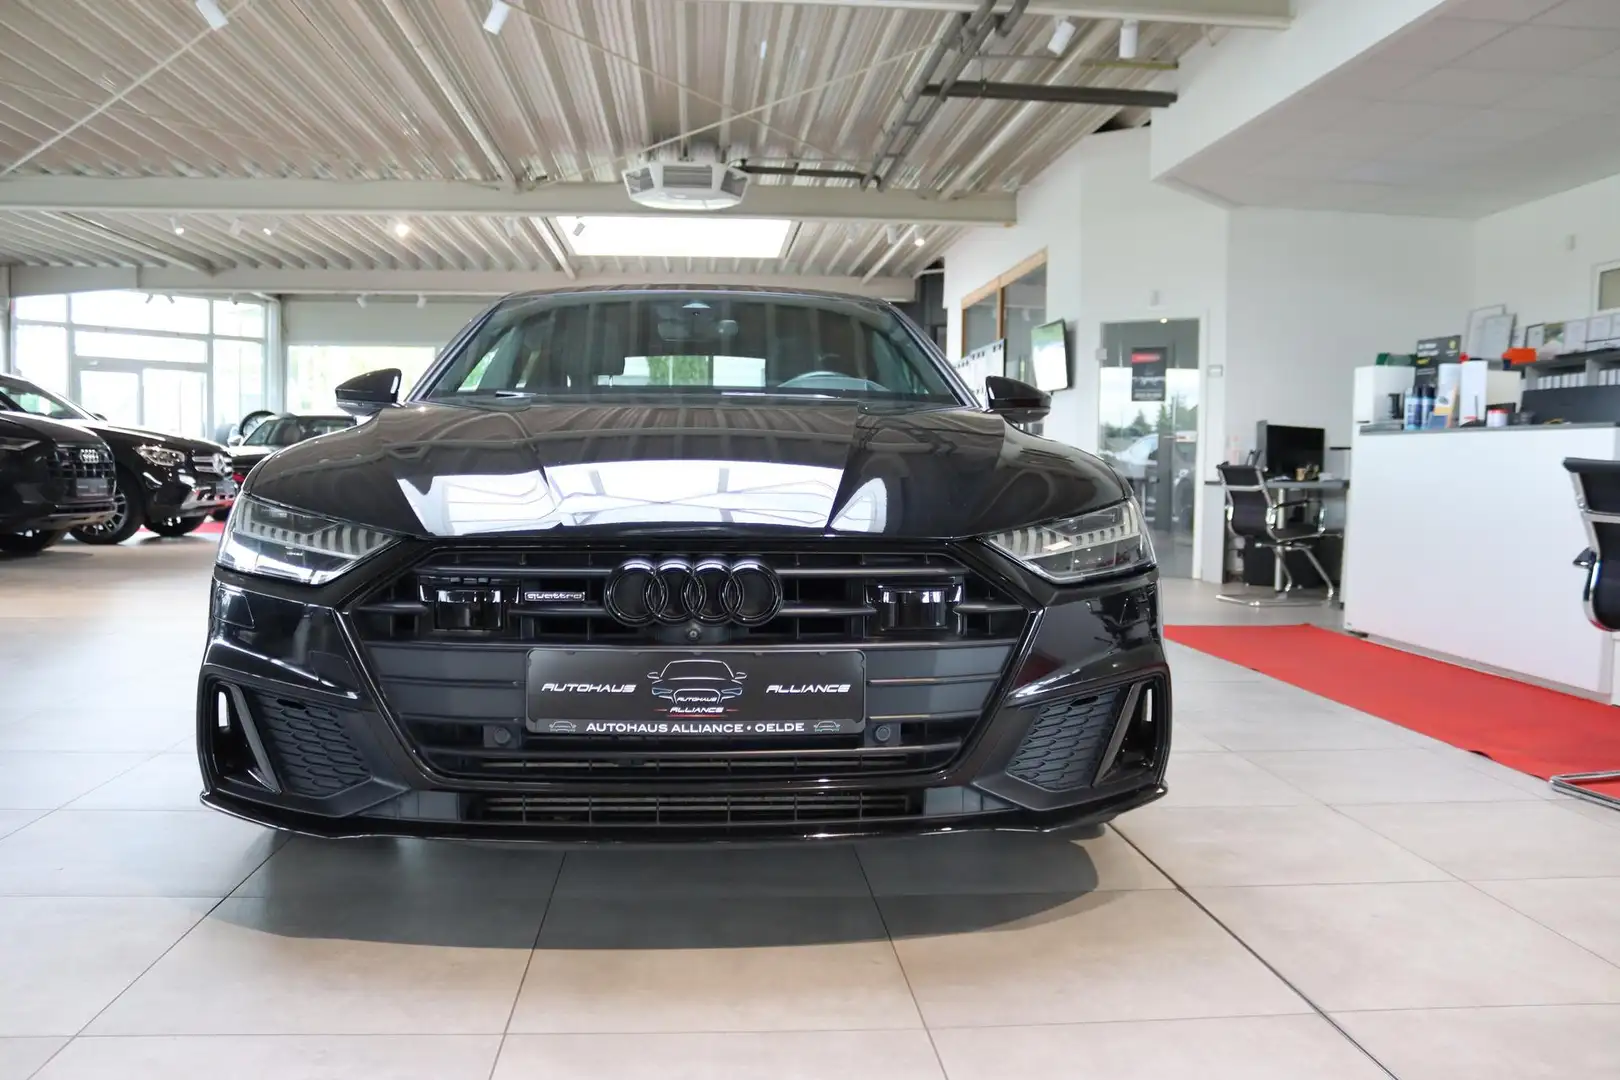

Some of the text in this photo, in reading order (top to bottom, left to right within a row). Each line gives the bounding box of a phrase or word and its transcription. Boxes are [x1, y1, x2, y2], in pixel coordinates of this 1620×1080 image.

[527, 592, 582, 600] quattro
[541, 682, 638, 693] AUTOHAUS
[765, 683, 852, 694] ALLIANCE
[585, 722, 805, 733] AUTOHAUS ALLIANCE OELDE
